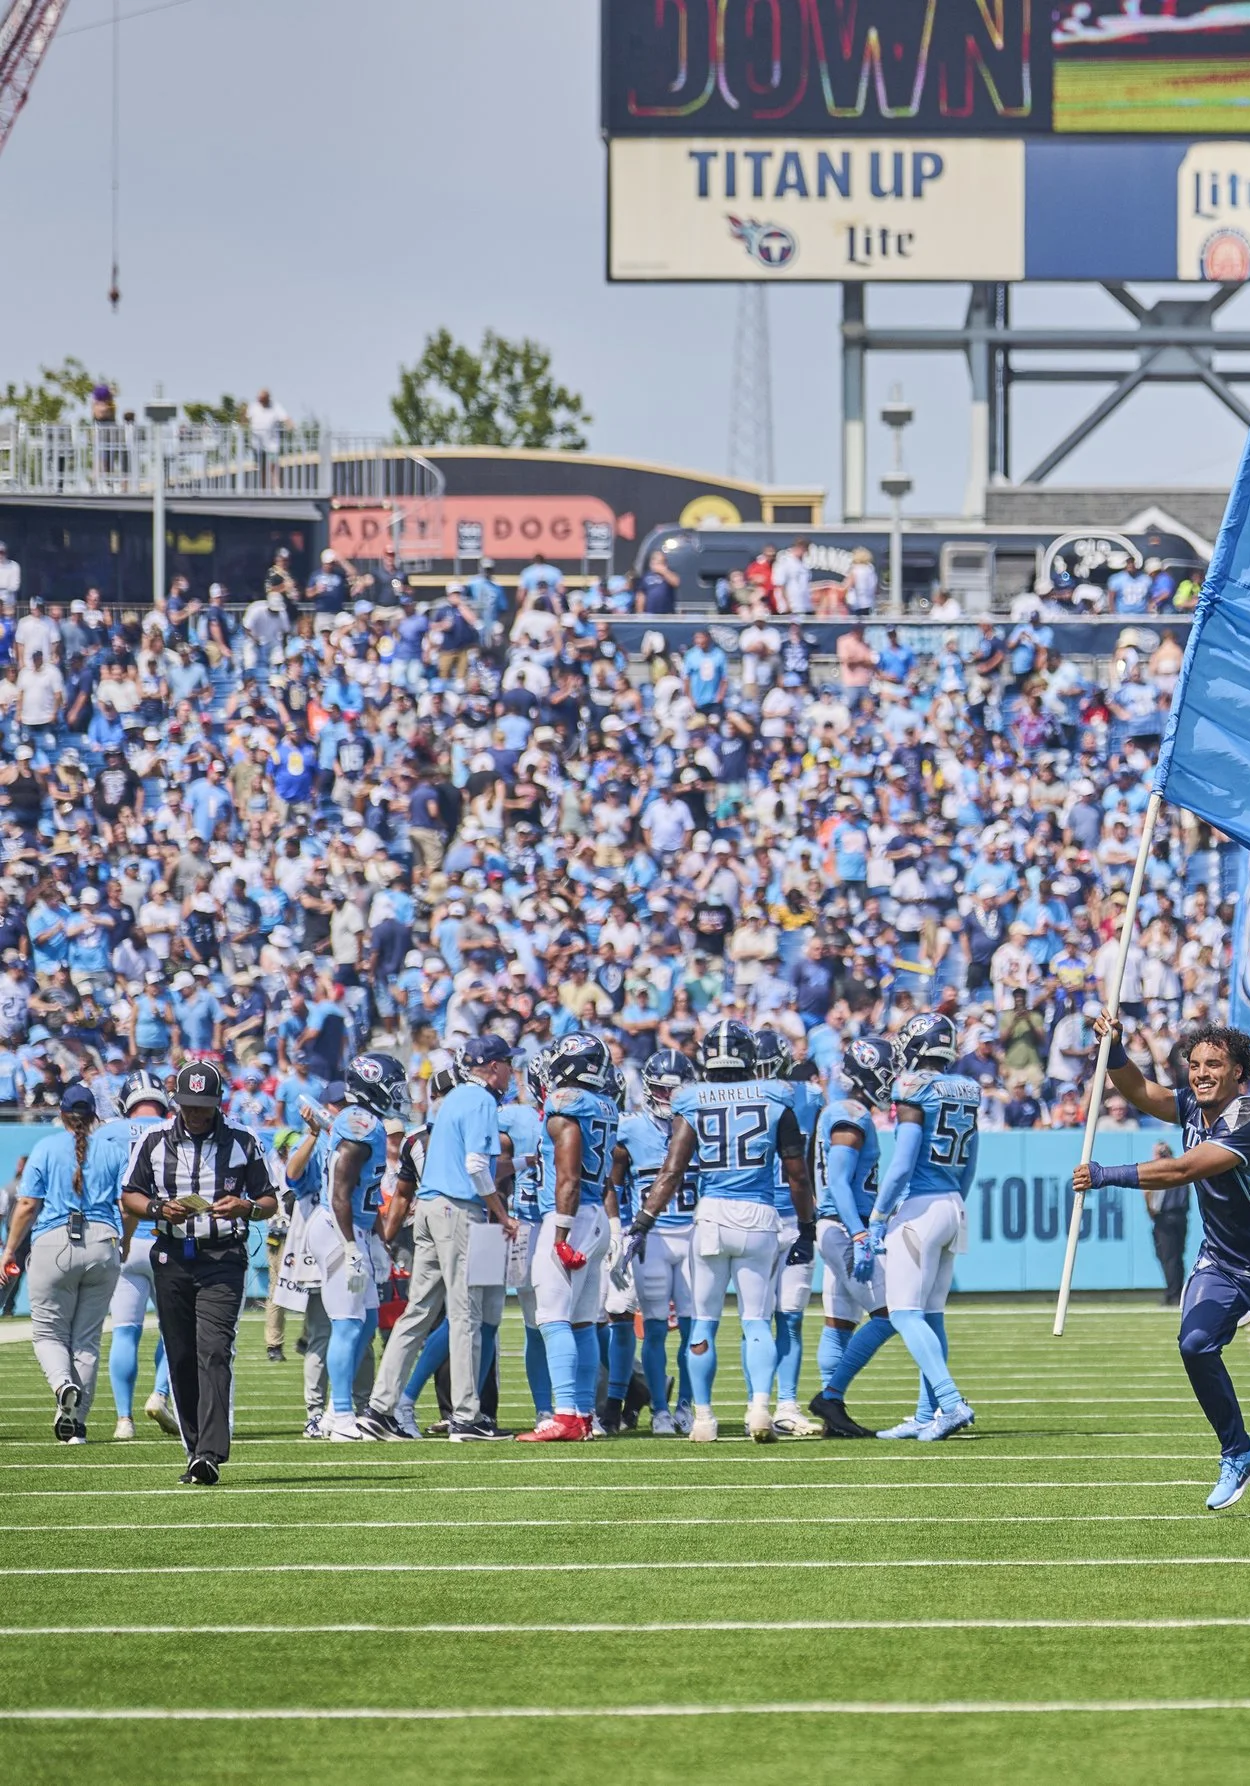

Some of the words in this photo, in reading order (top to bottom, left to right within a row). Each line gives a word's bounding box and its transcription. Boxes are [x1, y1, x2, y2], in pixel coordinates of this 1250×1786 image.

[688, 151, 852, 198] TITAN
[870, 151, 944, 198] UP
[843, 222, 916, 266] Lite
[698, 1085, 766, 1105] HARRELL
[696, 1103, 769, 1172] 92
[929, 1101, 979, 1167] 52
[978, 1176, 1124, 1241] TOUGH
